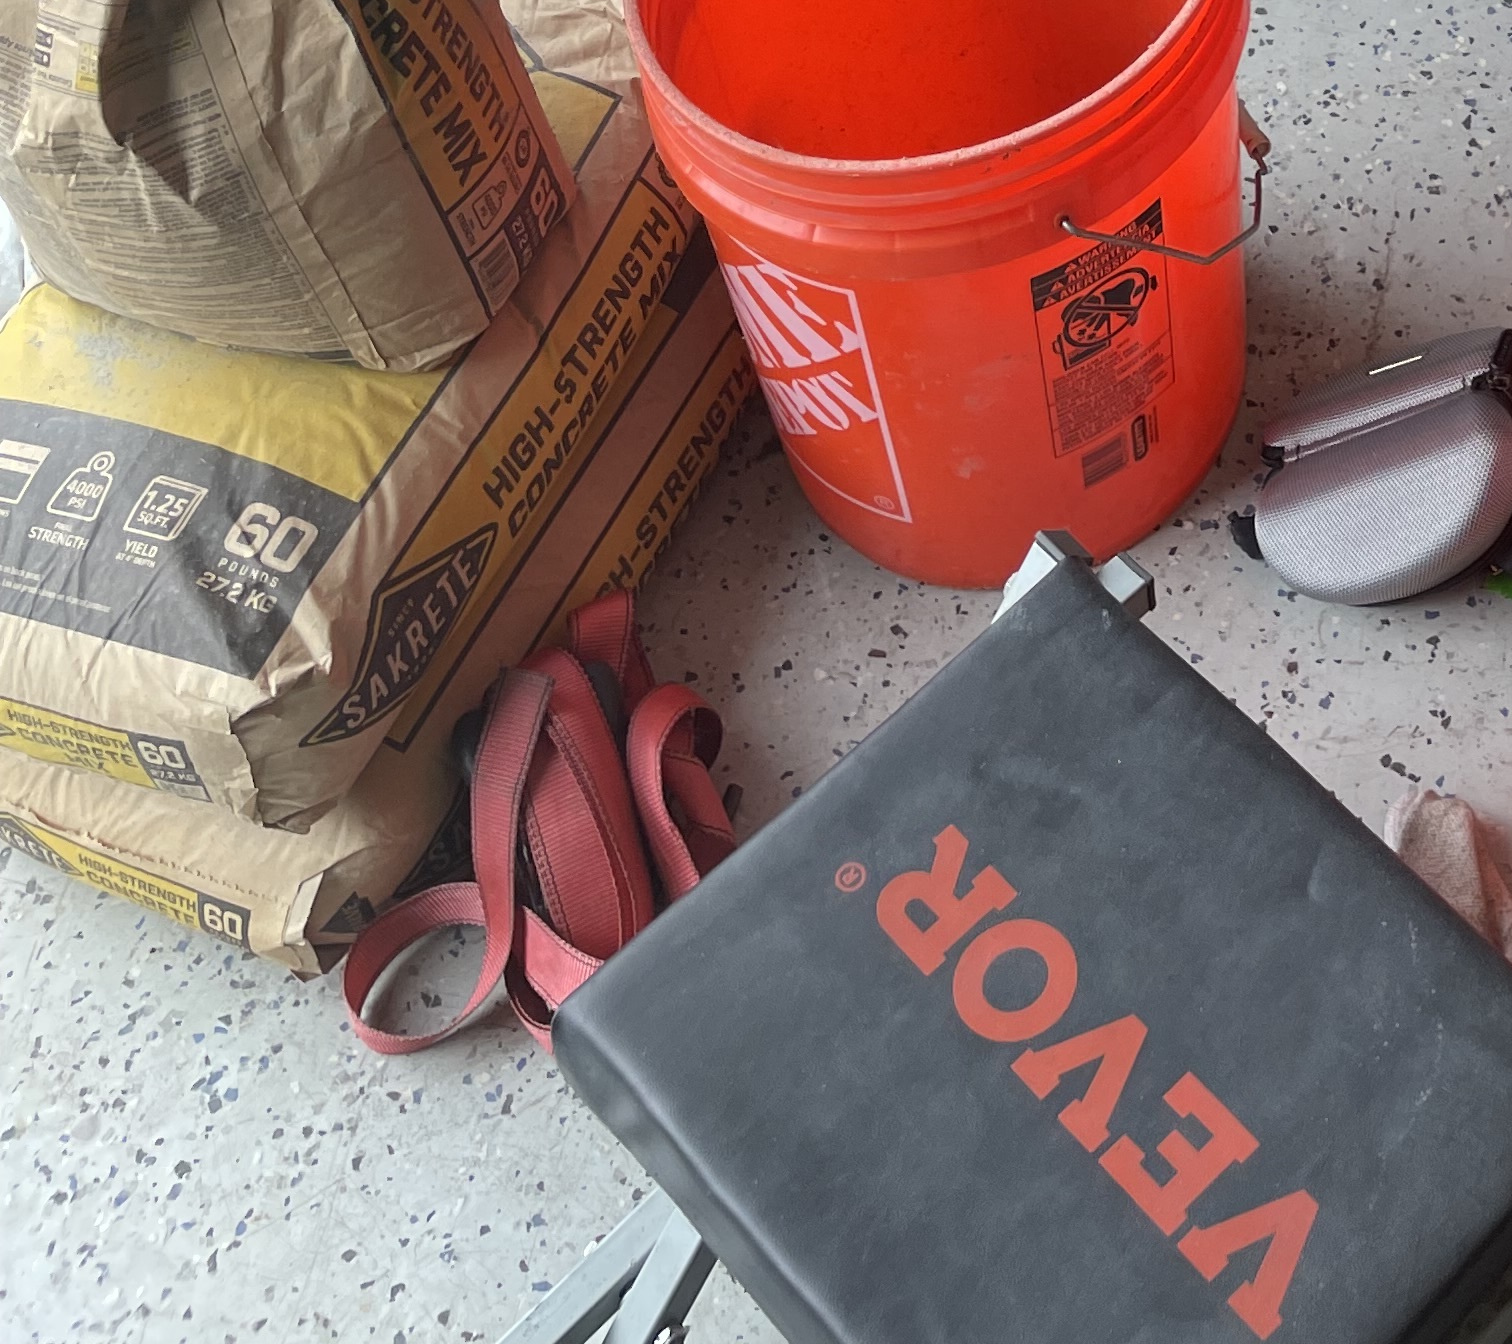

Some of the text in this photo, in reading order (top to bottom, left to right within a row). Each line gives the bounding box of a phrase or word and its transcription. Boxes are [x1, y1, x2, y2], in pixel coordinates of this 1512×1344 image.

[432, 101, 488, 187] MIX
[483, 206, 670, 509] HIGH-STRENGTH
[507, 316, 639, 539] CONCRETE
[66, 479, 104, 499] 4000
[67, 496, 88, 509] PSI
[142, 489, 189, 517] 1.25
[28, 526, 90, 551] STRENGTH
[124, 539, 159, 558] YIELD
[223, 502, 319, 573] 60
[195, 571, 279, 614] 27.2 KG
[218, 557, 280, 589] POUNDS
[342, 549, 478, 729] SAKRETE
[7, 708, 134, 752] HIGH-STRENGTH
[16, 726, 139, 769] CONCRETE
[137, 740, 187, 769] 60
[78, 853, 197, 912] HIGH-STRENGTH
[203, 902, 243, 941] 60
[876, 824, 1320, 1340] VEVOR
